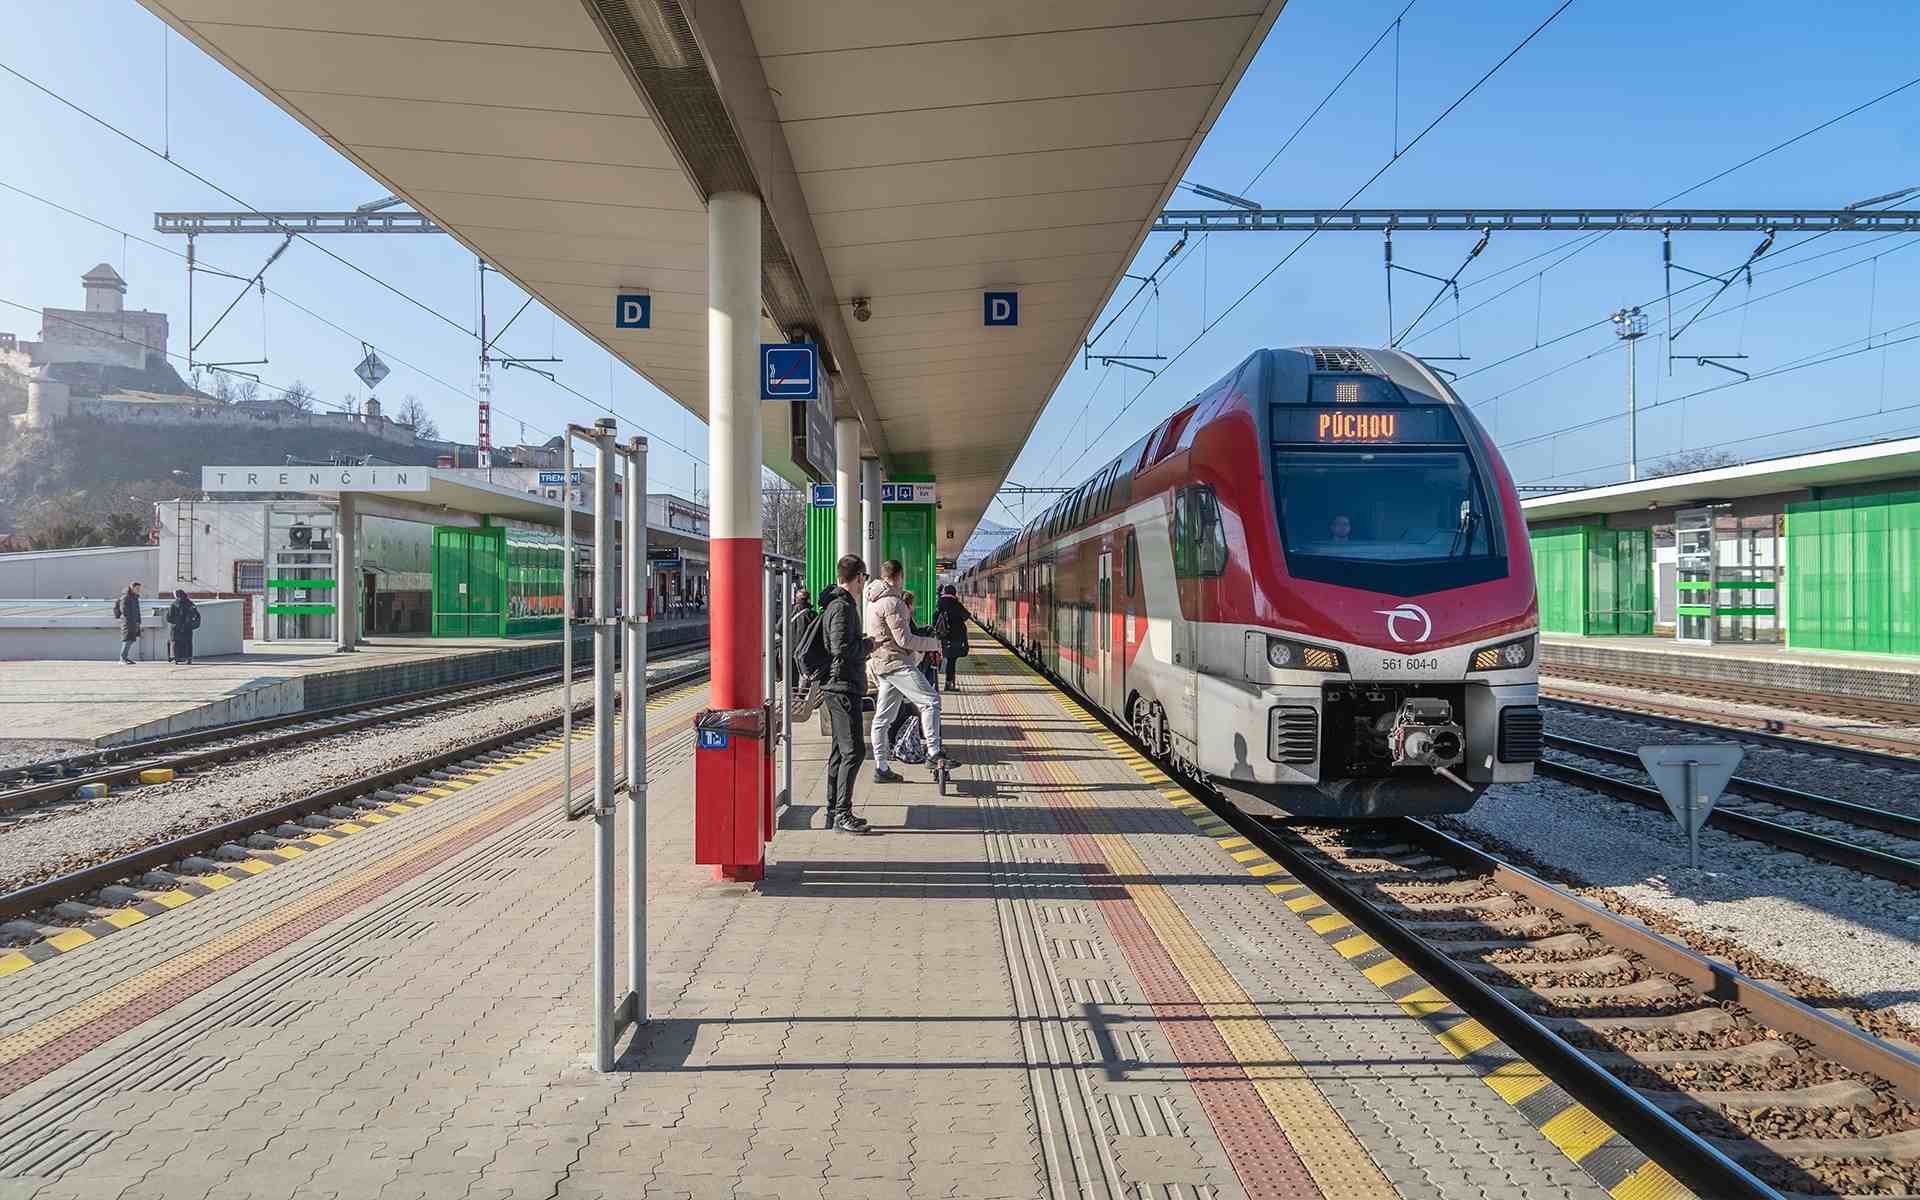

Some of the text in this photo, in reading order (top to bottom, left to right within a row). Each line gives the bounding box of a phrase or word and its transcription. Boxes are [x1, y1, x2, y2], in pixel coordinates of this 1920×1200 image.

[624, 302, 642, 322] D
[992, 299, 1010, 320] D
[1319, 411, 1394, 438] PÚCHOV
[217, 470, 408, 485] TRENČÍN
[540, 474, 577, 482] TRENN
[1382, 658, 1438, 670] 561 604-0
